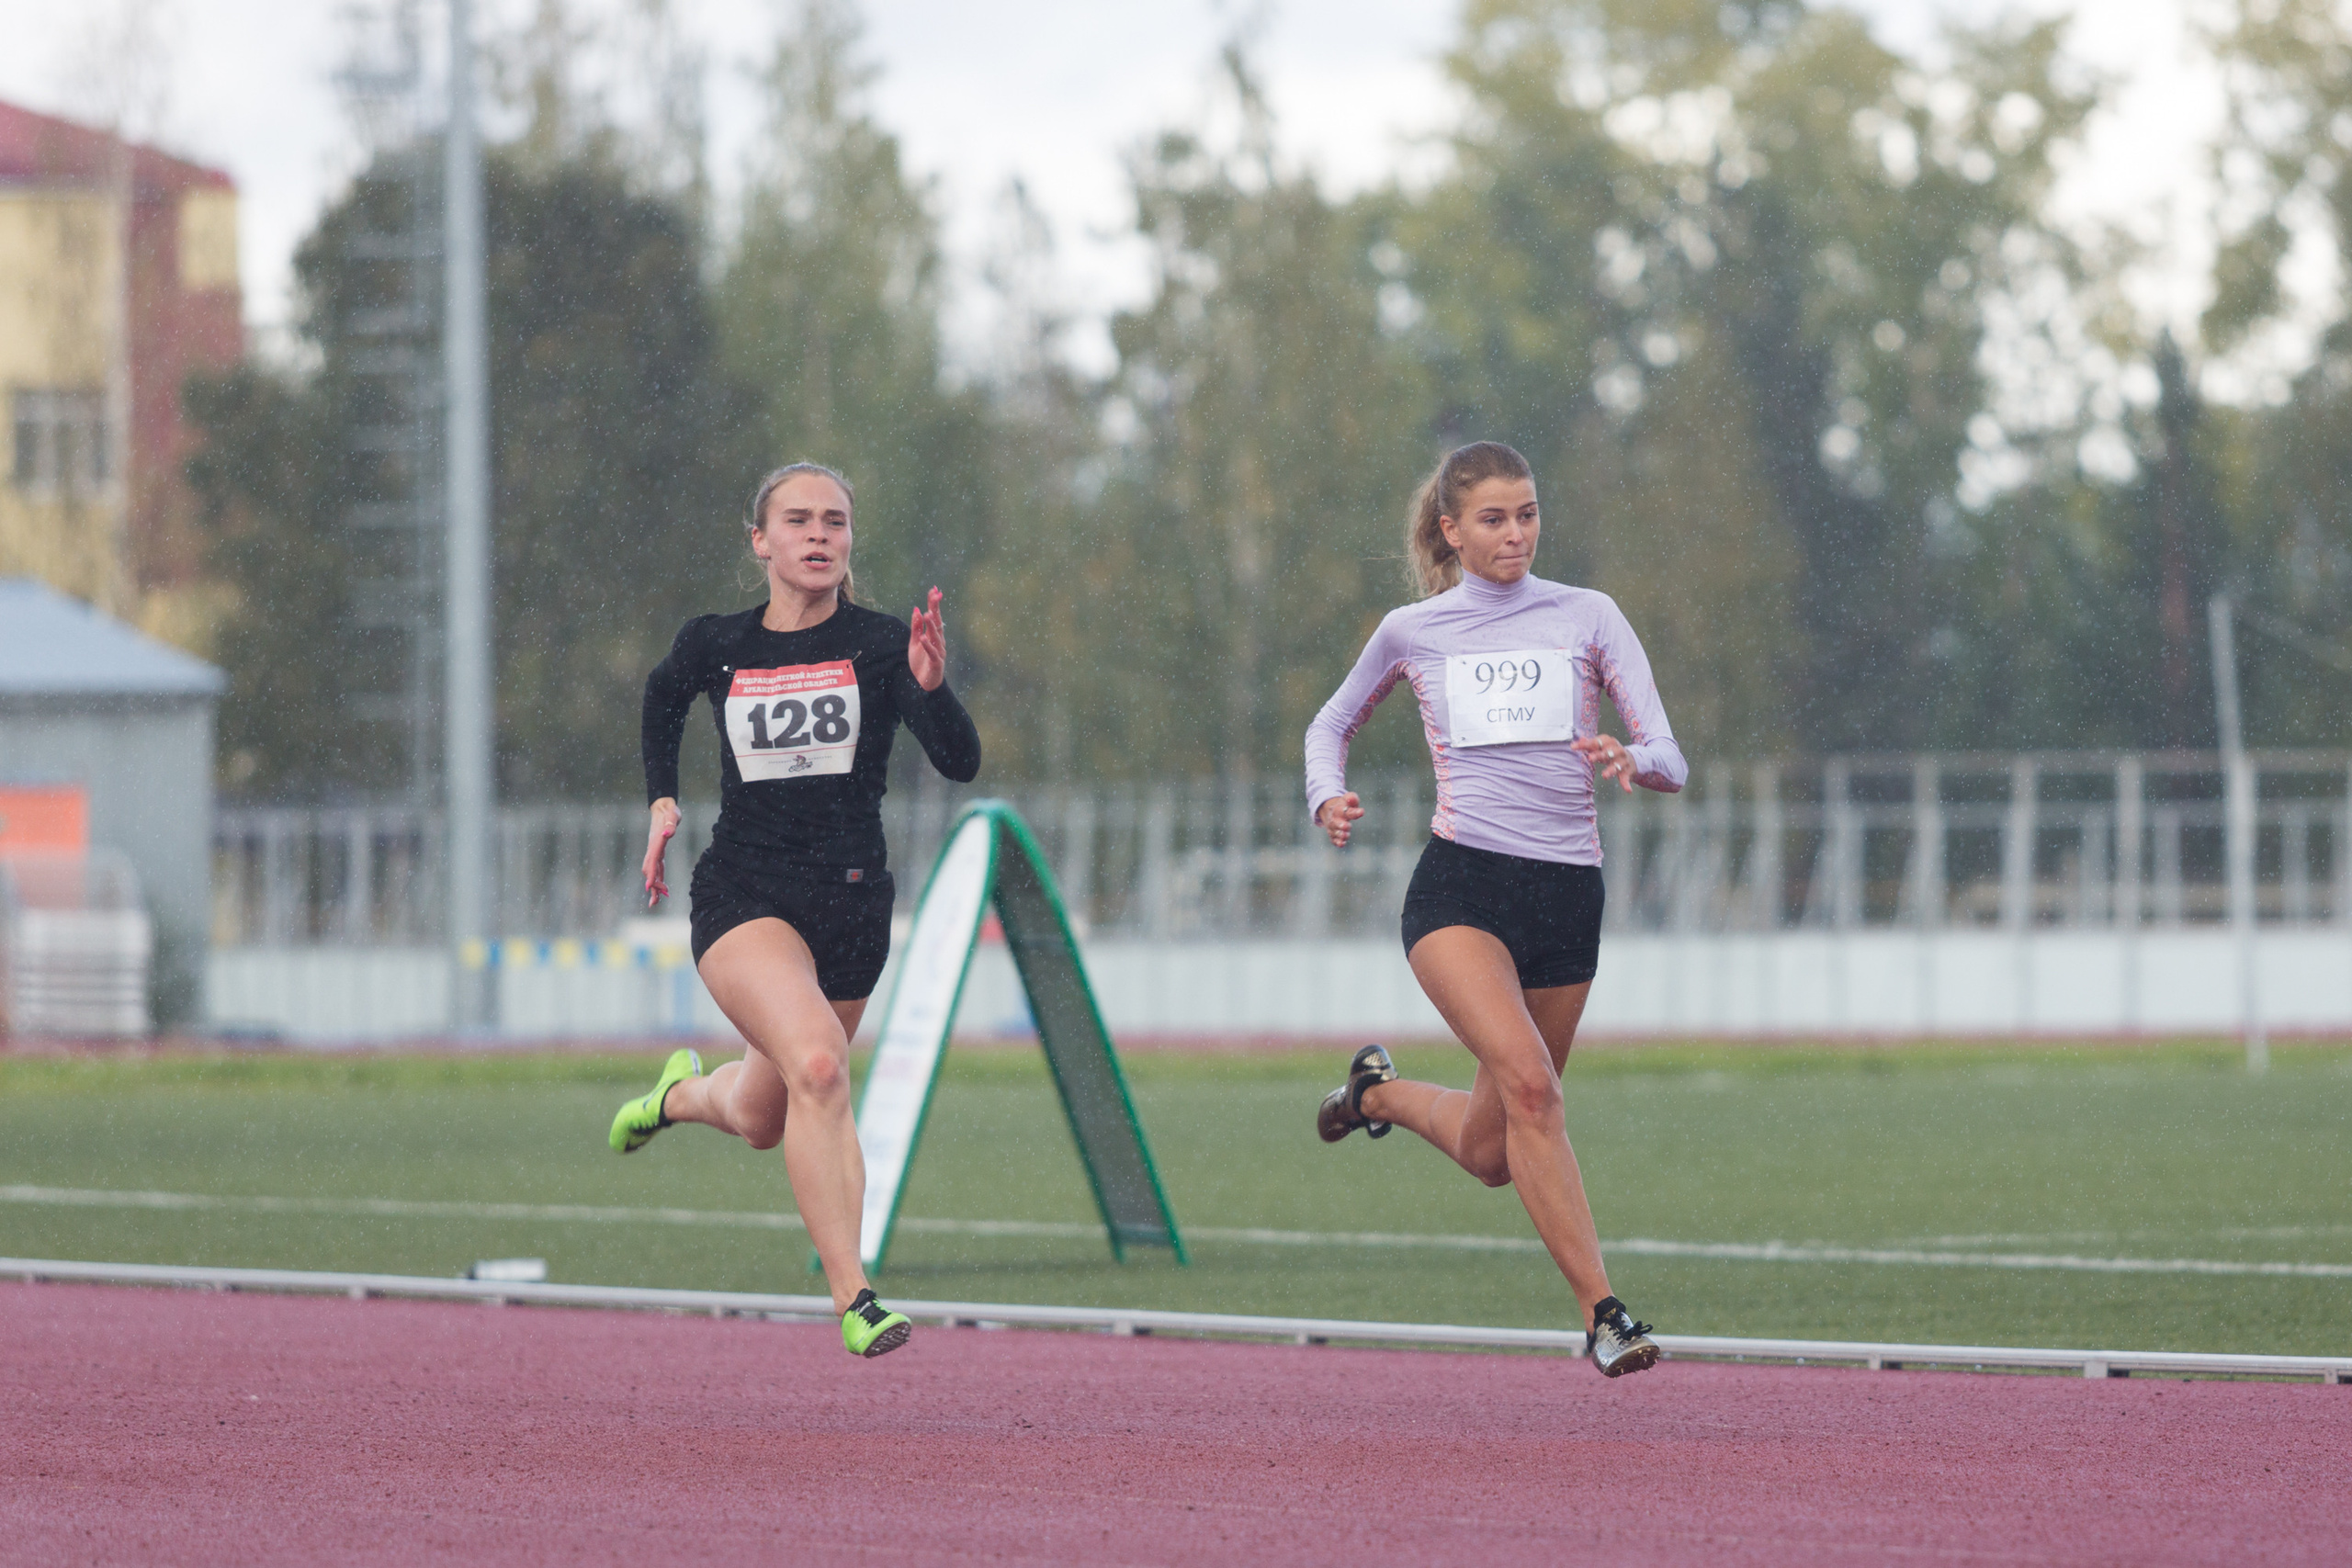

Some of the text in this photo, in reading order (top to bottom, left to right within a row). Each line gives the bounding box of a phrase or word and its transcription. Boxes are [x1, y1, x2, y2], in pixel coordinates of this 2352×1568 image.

[806, 669, 843, 679] АТЛЕТИКИ
[1475, 659, 1542, 695] 999
[803, 678, 839, 688] ОБЛАСТИ
[747, 694, 851, 750] 128
[1487, 706, 1535, 723] СГМУ
